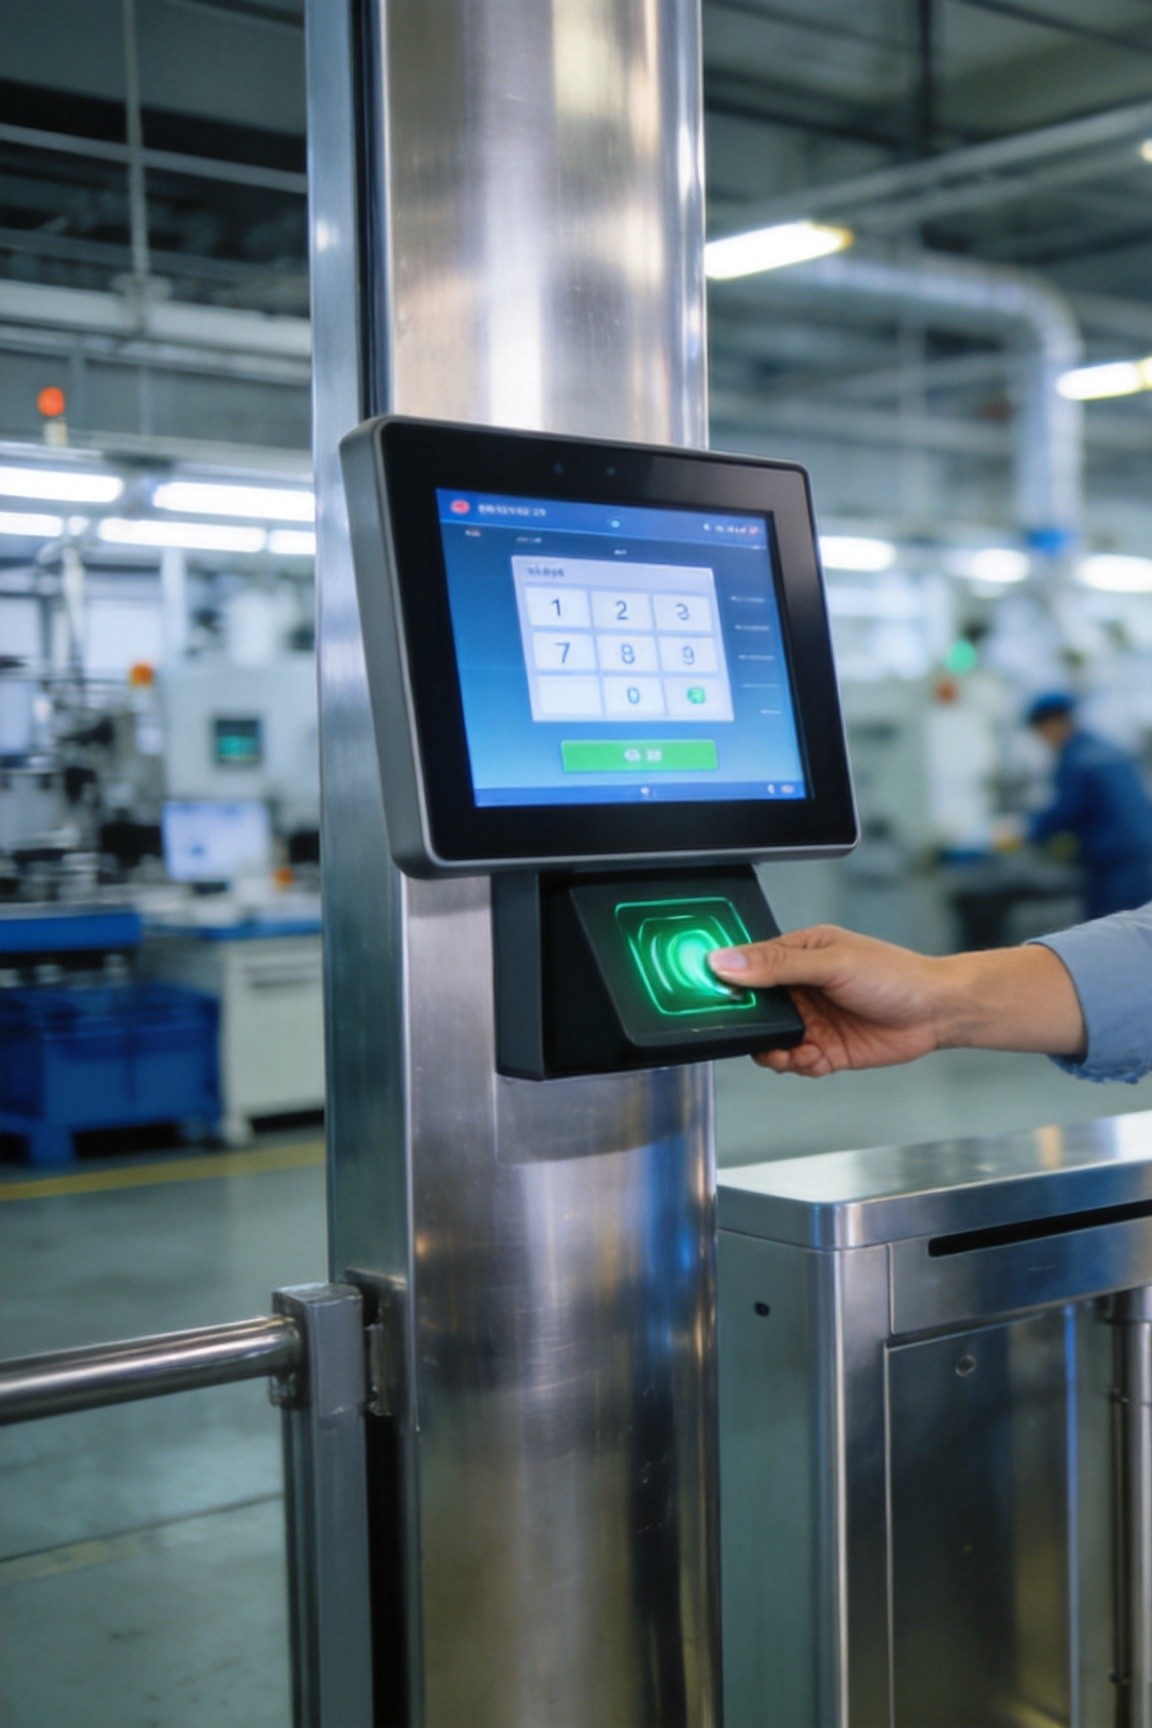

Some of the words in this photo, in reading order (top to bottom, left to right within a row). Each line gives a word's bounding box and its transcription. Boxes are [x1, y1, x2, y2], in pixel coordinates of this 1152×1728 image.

[552, 598, 562, 617] 1
[615, 600, 629, 621] 2
[675, 603, 690, 621] 3
[554, 642, 571, 664] 7
[620, 643, 636, 664] 8
[681, 645, 695, 665] 9
[626, 687, 641, 705] 0
